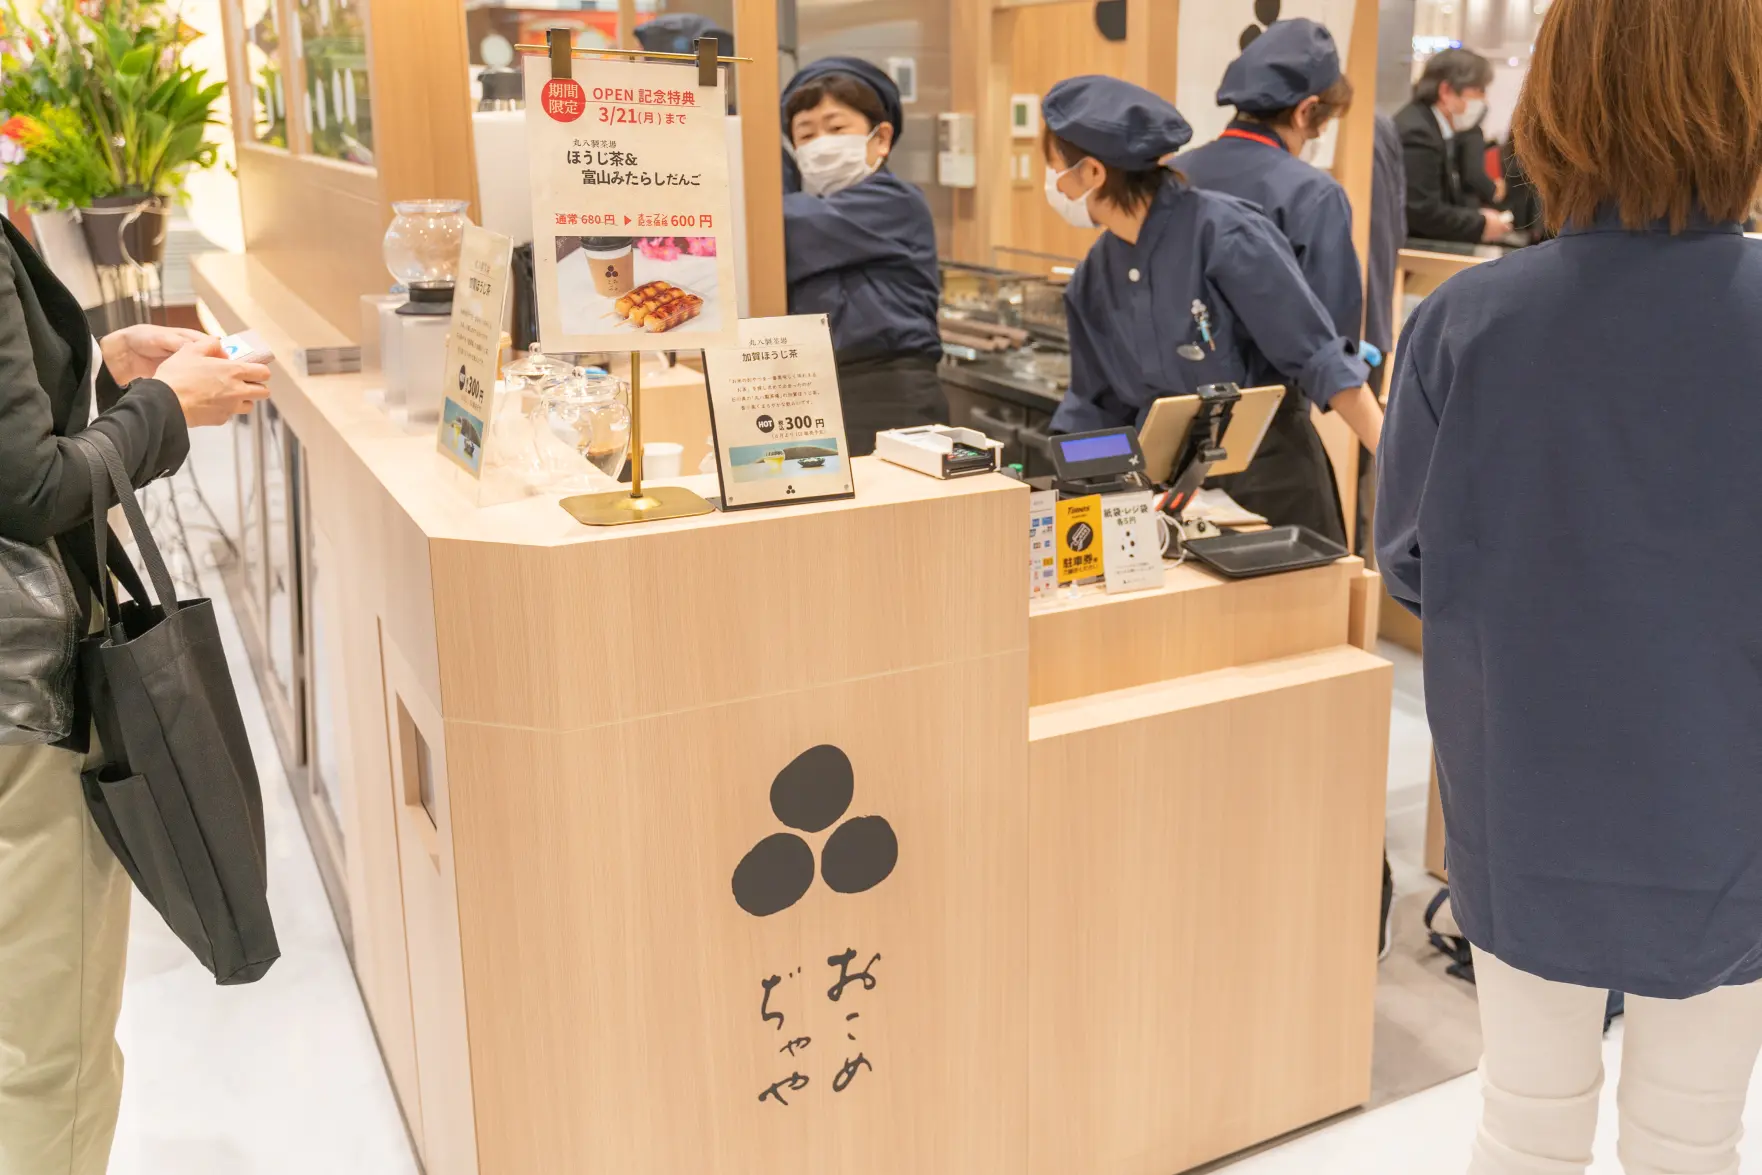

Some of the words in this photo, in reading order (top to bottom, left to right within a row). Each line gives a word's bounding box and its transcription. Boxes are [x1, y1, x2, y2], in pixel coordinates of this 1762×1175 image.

[548, 83, 579, 99] 期間
[593, 87, 634, 102] OPEN
[638, 88, 696, 106] 記念特典
[549, 99, 580, 115] 限定
[567, 150, 638, 167] ほうじ茶&
[581, 169, 702, 187] 富山みたらしだんご
[742, 349, 798, 362] 加賀ほうじ茶
[758, 420, 773, 428] HOT
[827, 947, 881, 1092] おこめ
[758, 966, 811, 1106] ぢゃや
